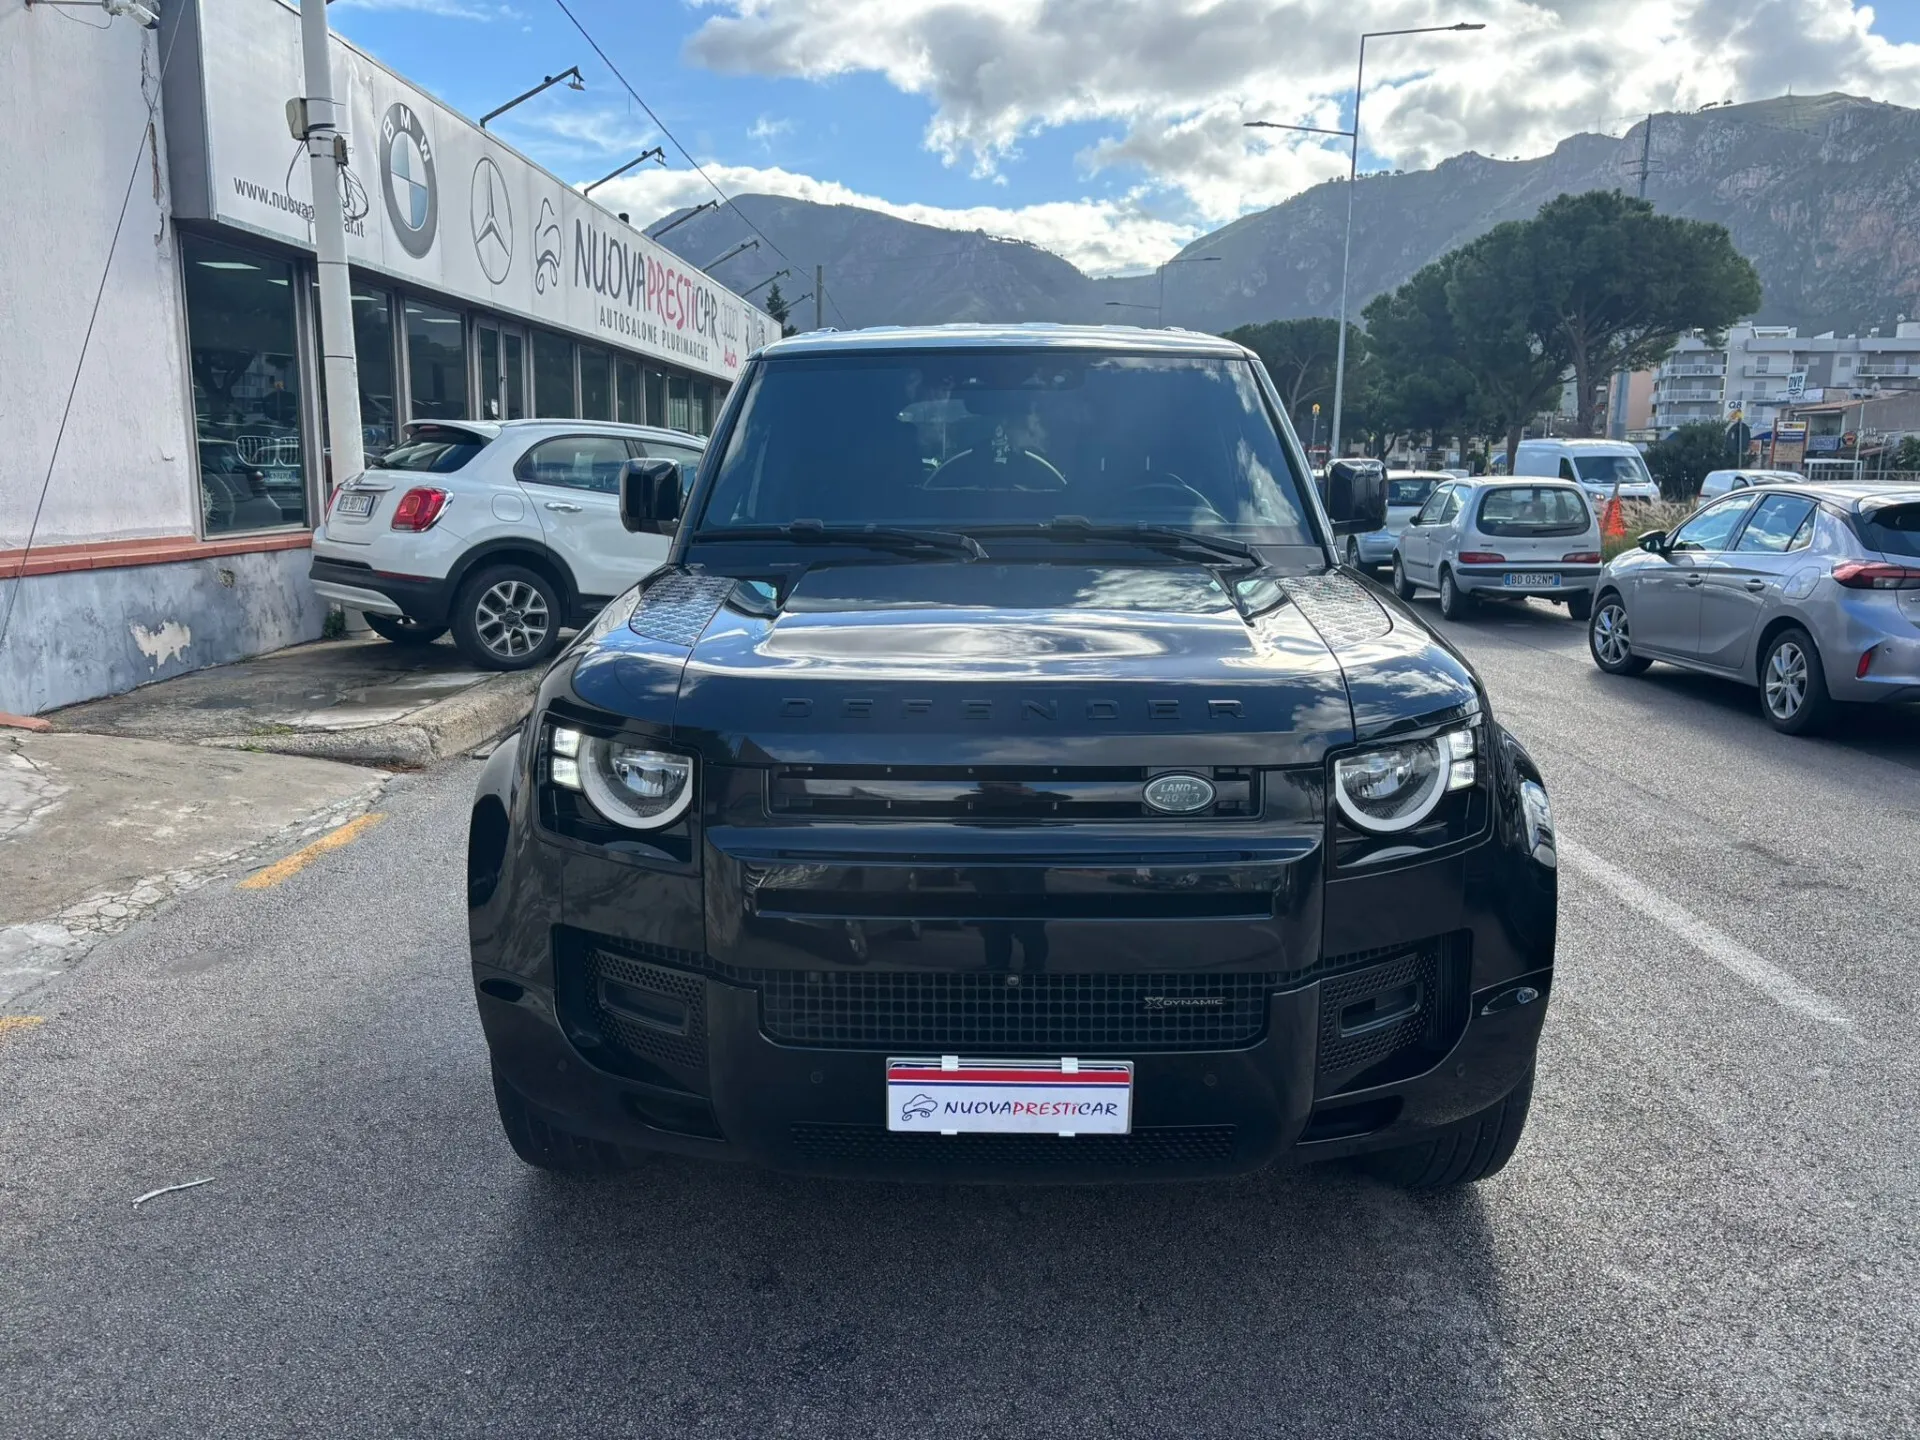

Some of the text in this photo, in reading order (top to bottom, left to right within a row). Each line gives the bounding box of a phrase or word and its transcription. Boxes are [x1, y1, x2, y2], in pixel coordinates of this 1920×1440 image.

[383, 104, 431, 162] BMW
[600, 305, 709, 362] AUTOSALONE PLURIMARCHE
[780, 697, 1247, 721] DEFENDER
